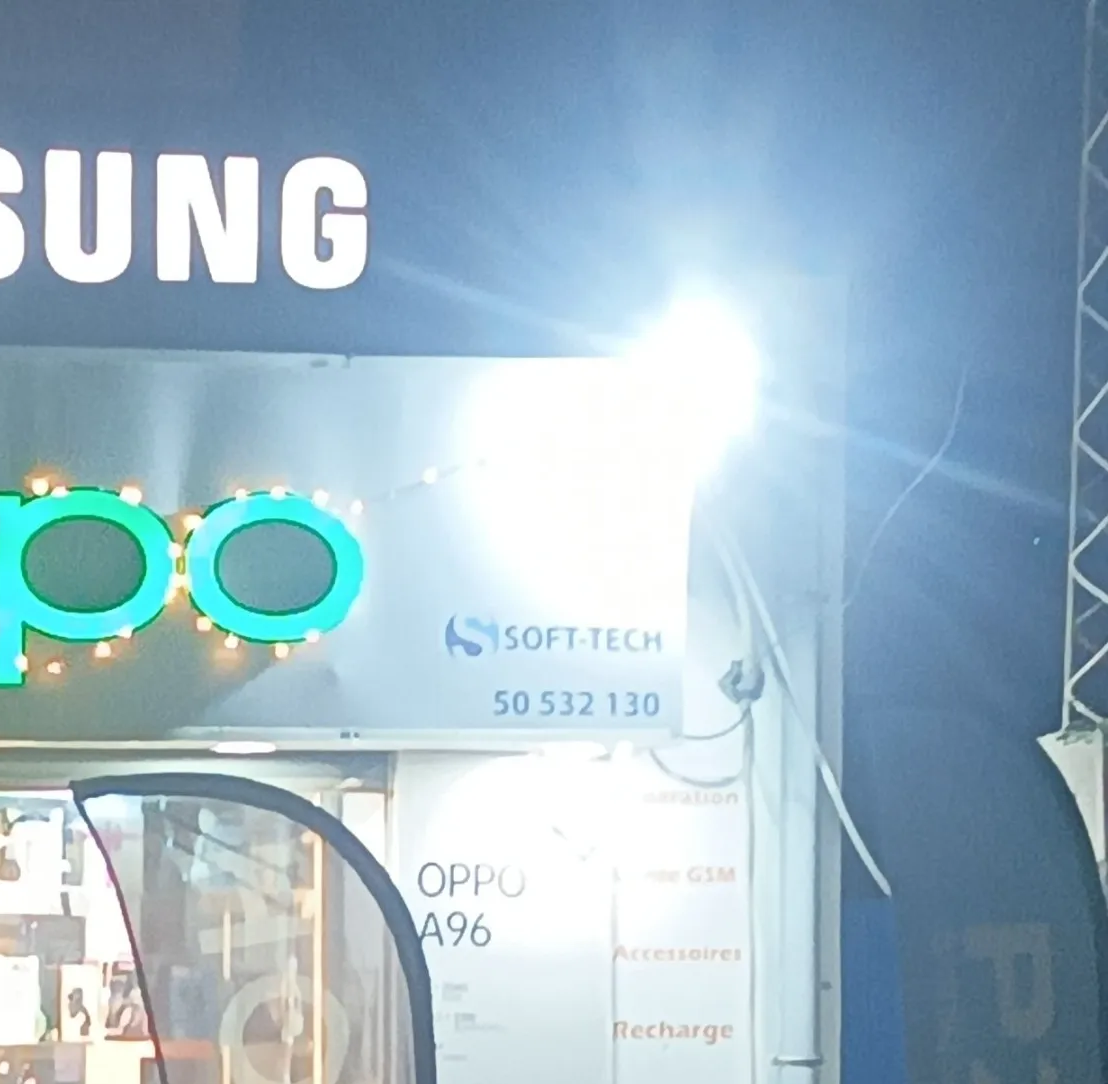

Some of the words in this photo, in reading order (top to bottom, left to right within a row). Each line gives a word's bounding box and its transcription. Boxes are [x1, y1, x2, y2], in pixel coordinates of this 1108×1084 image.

[504, 625, 663, 653] SOFT-TECH
[494, 690, 530, 716] 50
[539, 690, 594, 716] 532
[607, 692, 660, 717] 130
[417, 861, 526, 898] OPPO
[420, 911, 492, 947] A96
[613, 945, 742, 961] Accessoires
[613, 1020, 734, 1045] Recharge
